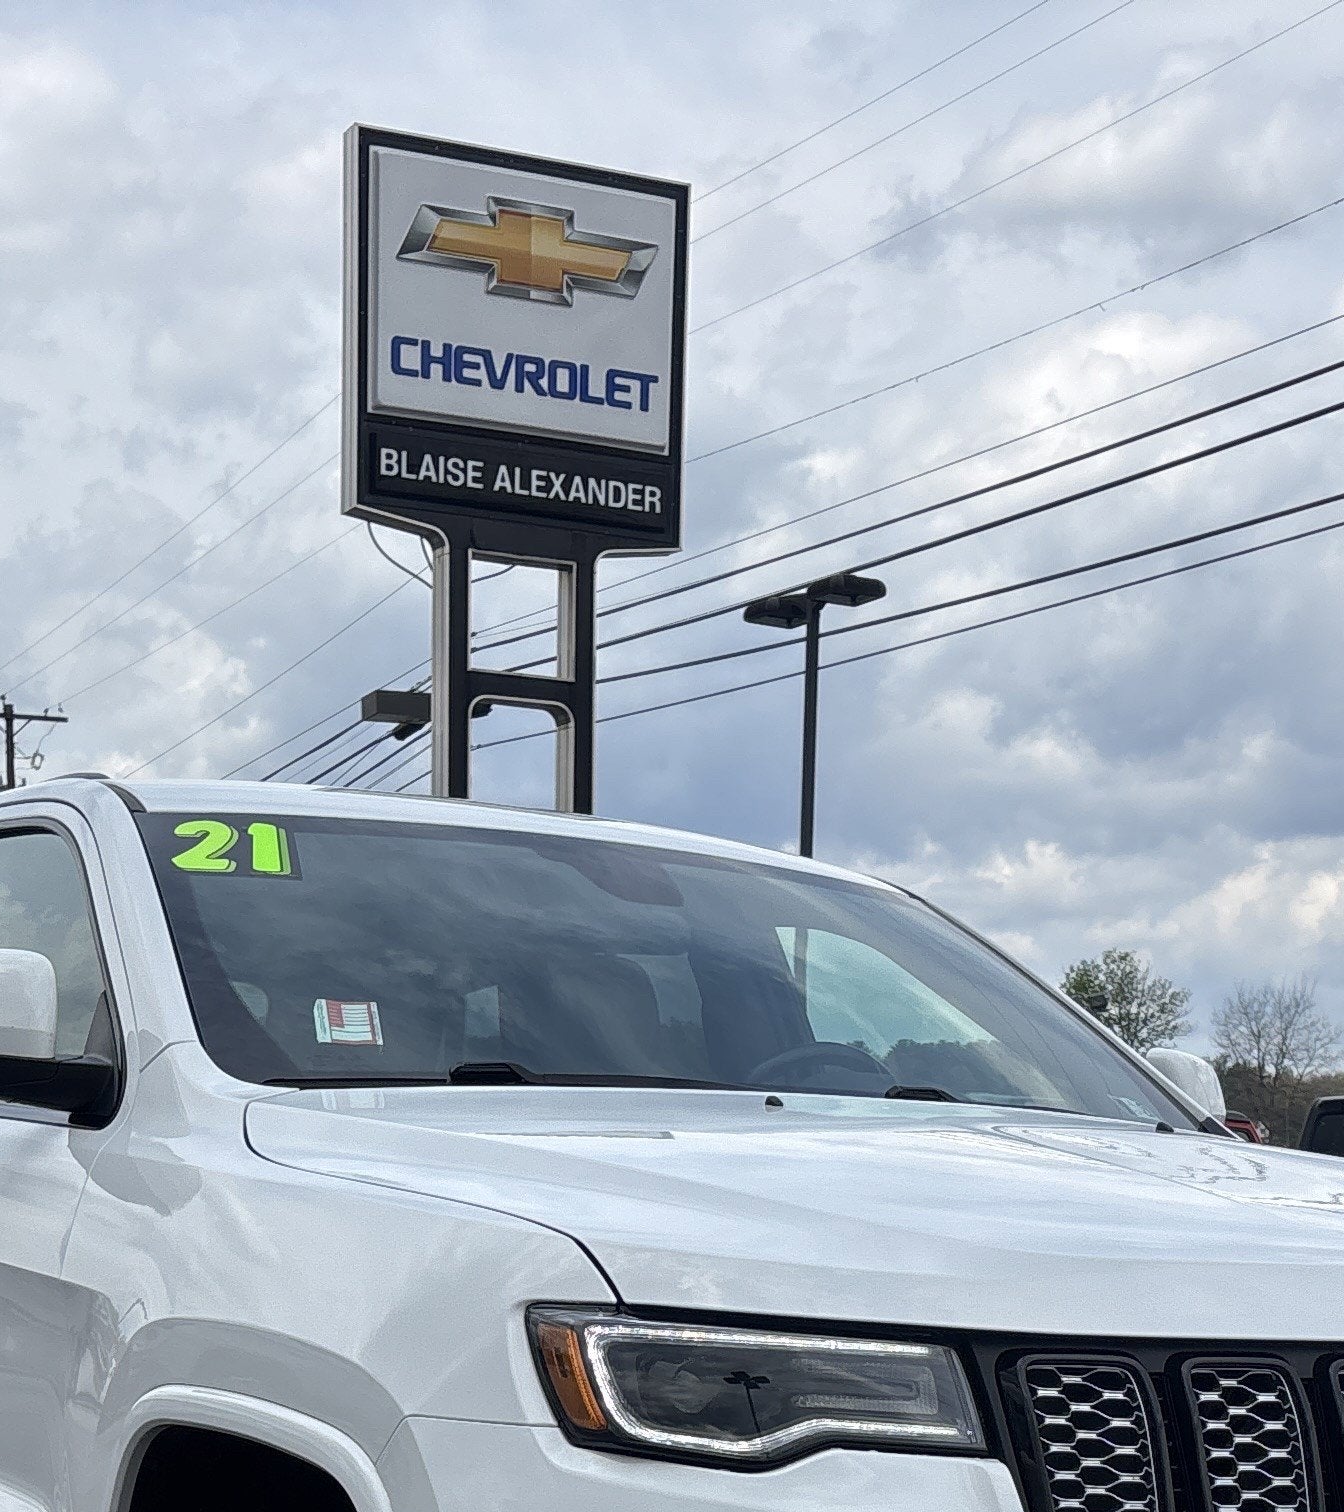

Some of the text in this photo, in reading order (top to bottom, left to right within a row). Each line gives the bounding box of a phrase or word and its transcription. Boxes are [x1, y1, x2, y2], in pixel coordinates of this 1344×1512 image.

[390, 335, 659, 412] CHEVROLET
[379, 448, 662, 514] BLAISE ALEXANDER
[170, 820, 293, 875] 21
